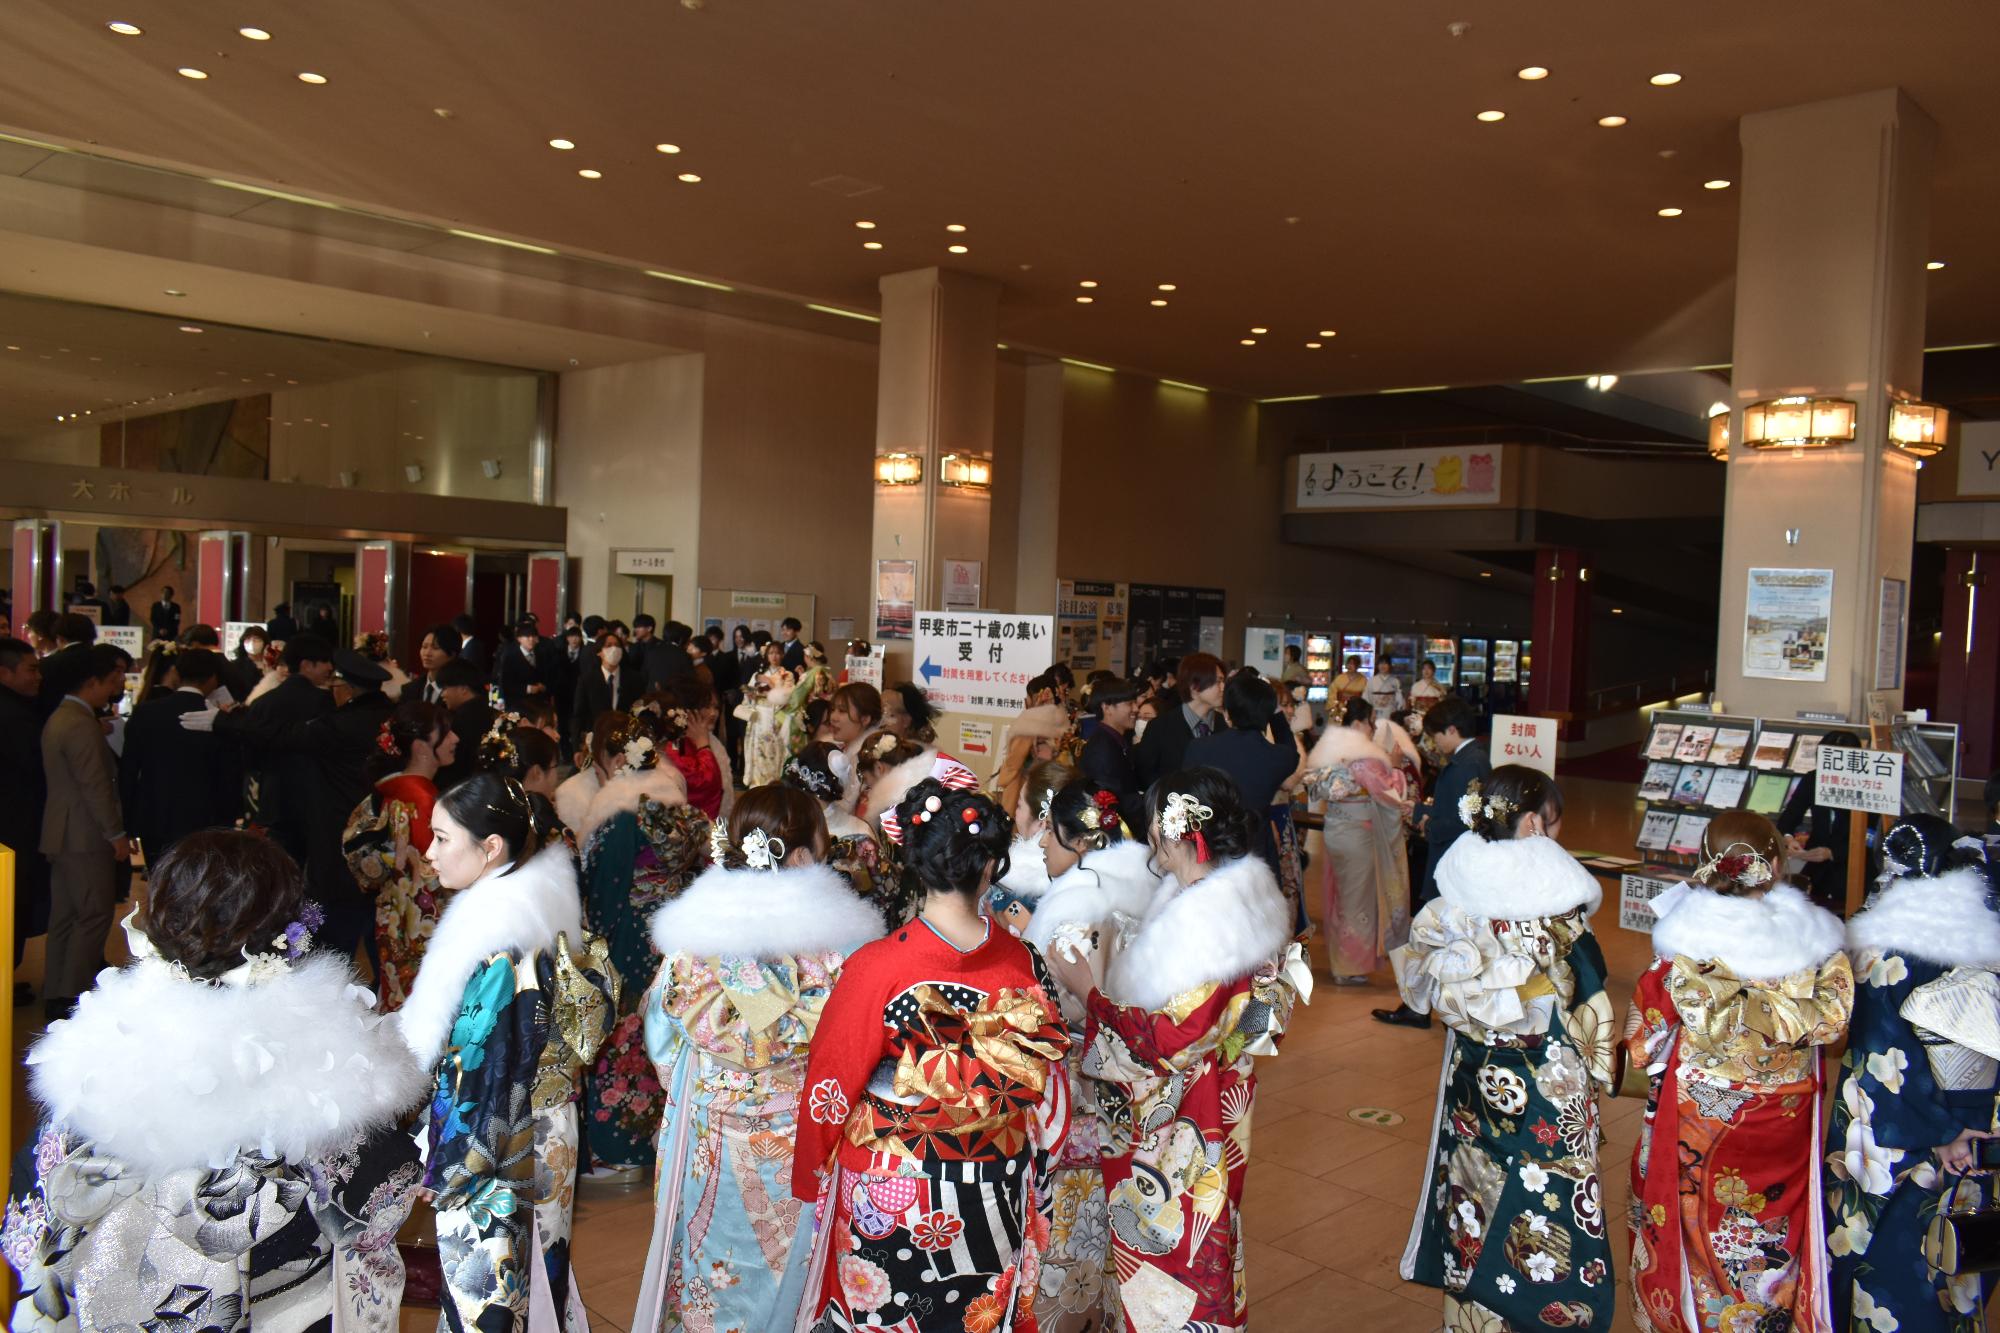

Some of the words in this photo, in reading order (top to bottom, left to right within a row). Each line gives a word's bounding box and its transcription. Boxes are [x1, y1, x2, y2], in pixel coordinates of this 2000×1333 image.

[72, 480, 192, 505] 大ホール
[919, 618, 1046, 641] 甲斐市二十歳の集い
[1511, 723, 1537, 738] 封筒
[1504, 742, 1542, 759] ない人
[1822, 747, 1896, 778] 記載台
[1820, 774, 1883, 790] 封筒ない方は
[1626, 876, 1664, 899] 記載
[1624, 900, 1653, 914] 封筒な
